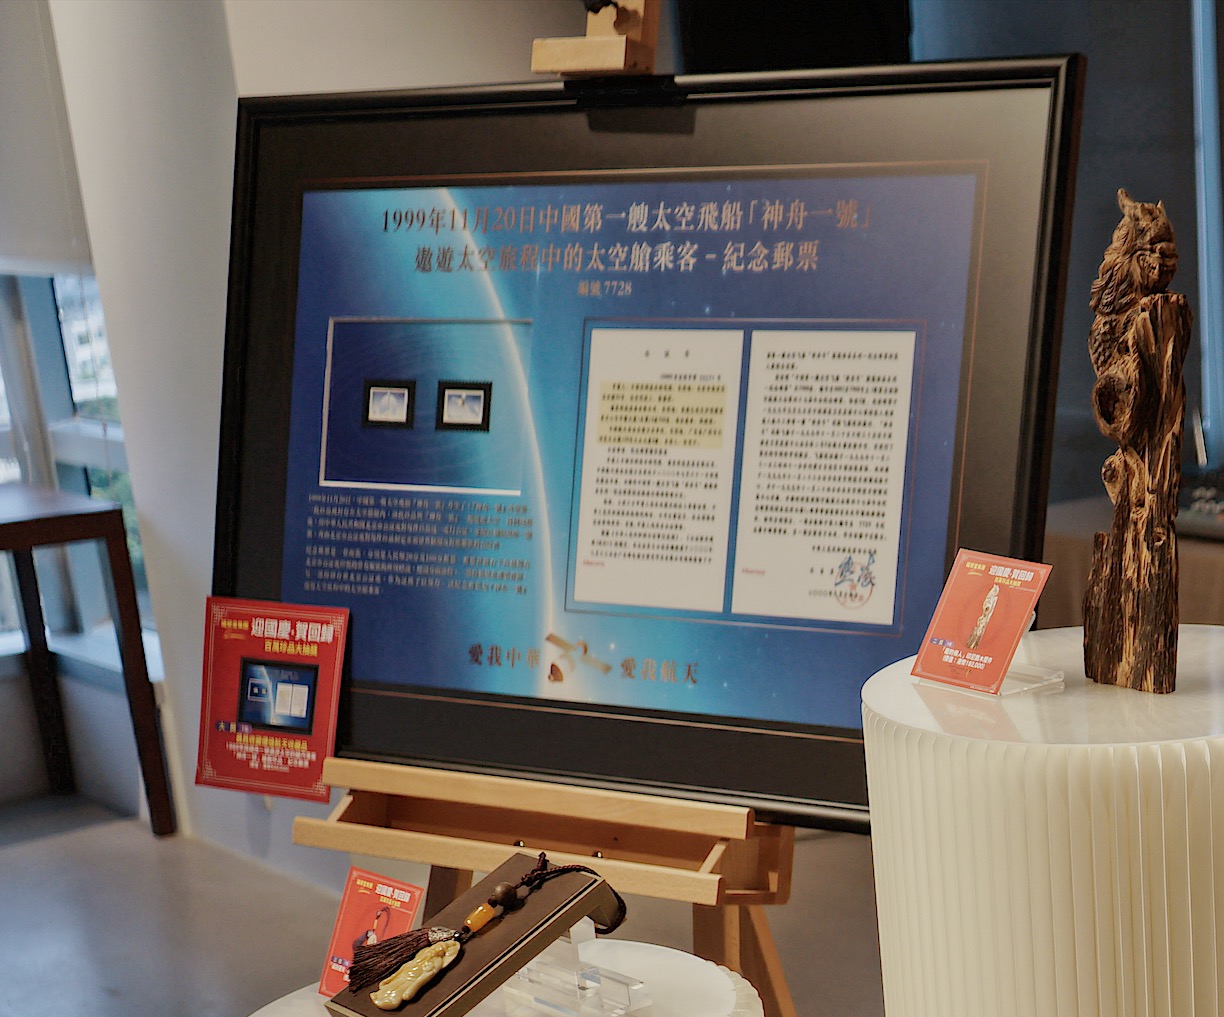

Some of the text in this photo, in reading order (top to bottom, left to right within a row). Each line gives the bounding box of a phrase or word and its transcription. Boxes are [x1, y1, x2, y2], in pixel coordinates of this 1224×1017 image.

[604, 280, 632, 296] 7728
[468, 643, 698, 684] 愛我中華 愛我航天
